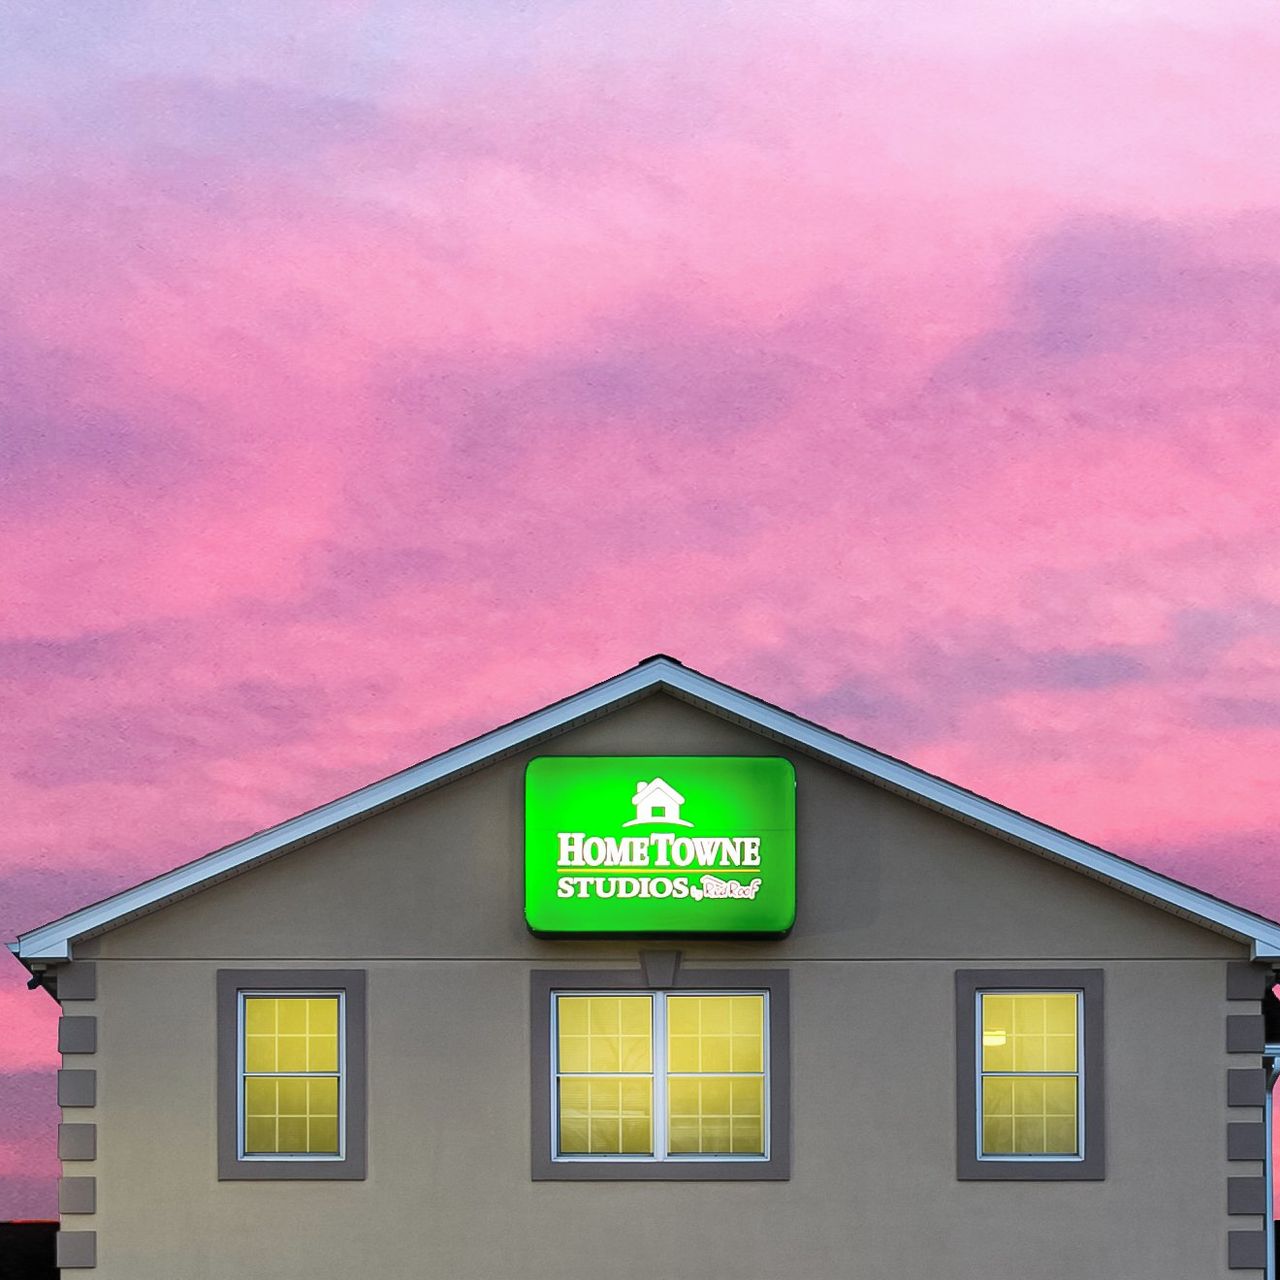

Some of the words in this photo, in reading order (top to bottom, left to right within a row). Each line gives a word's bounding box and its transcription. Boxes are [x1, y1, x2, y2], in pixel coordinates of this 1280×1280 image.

[557, 832, 761, 866] HOMETOWNE
[557, 877, 689, 899] STUDIOS
[728, 879, 761, 899] Roof
